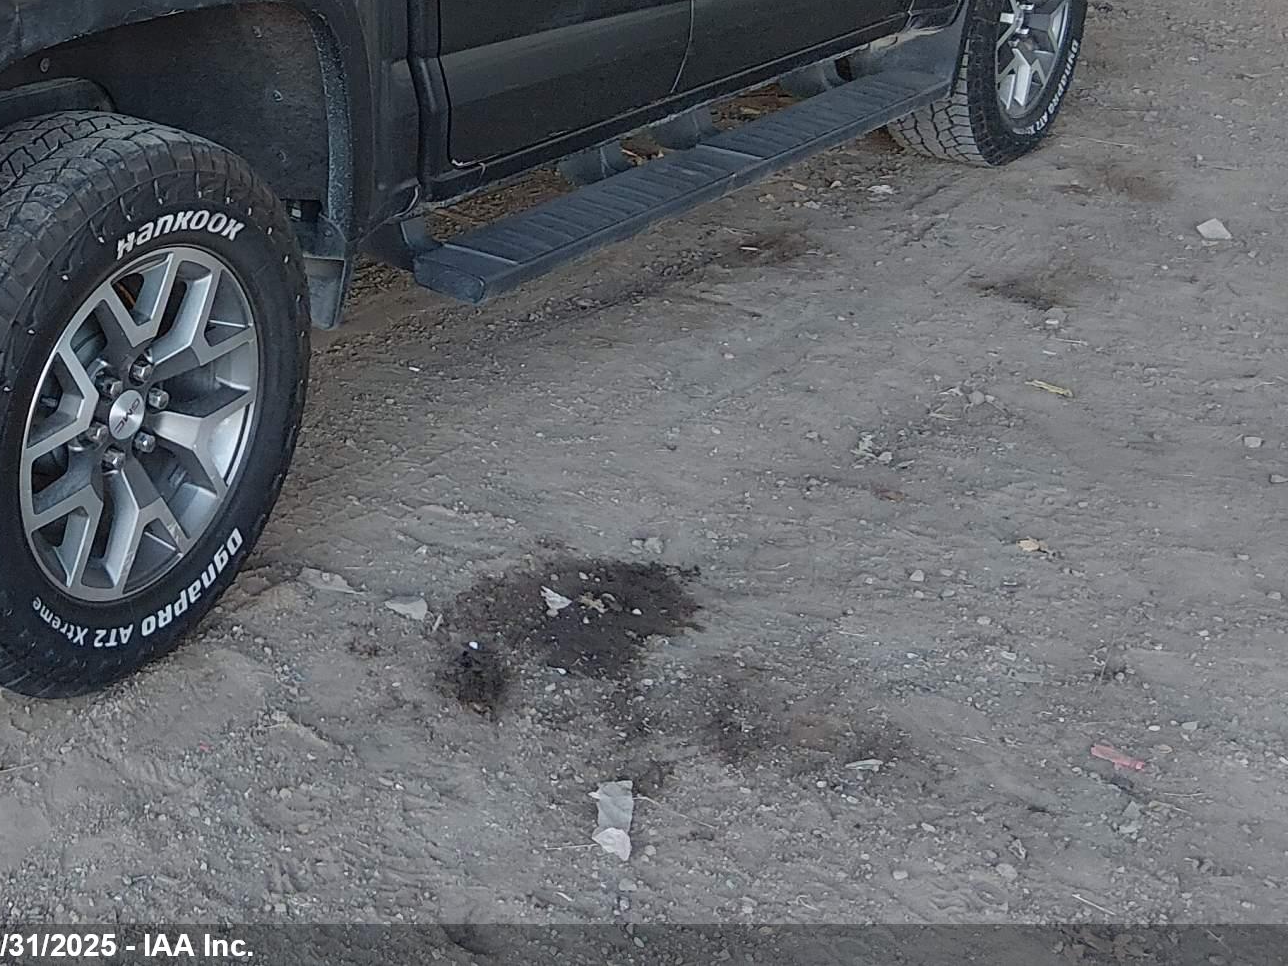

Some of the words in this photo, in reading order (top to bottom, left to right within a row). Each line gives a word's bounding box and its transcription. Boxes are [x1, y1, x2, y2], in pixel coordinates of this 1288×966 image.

[114, 398, 140, 434] GMC
[32, 596, 88, 645] Xtreme
[94, 624, 134, 647] AT2
